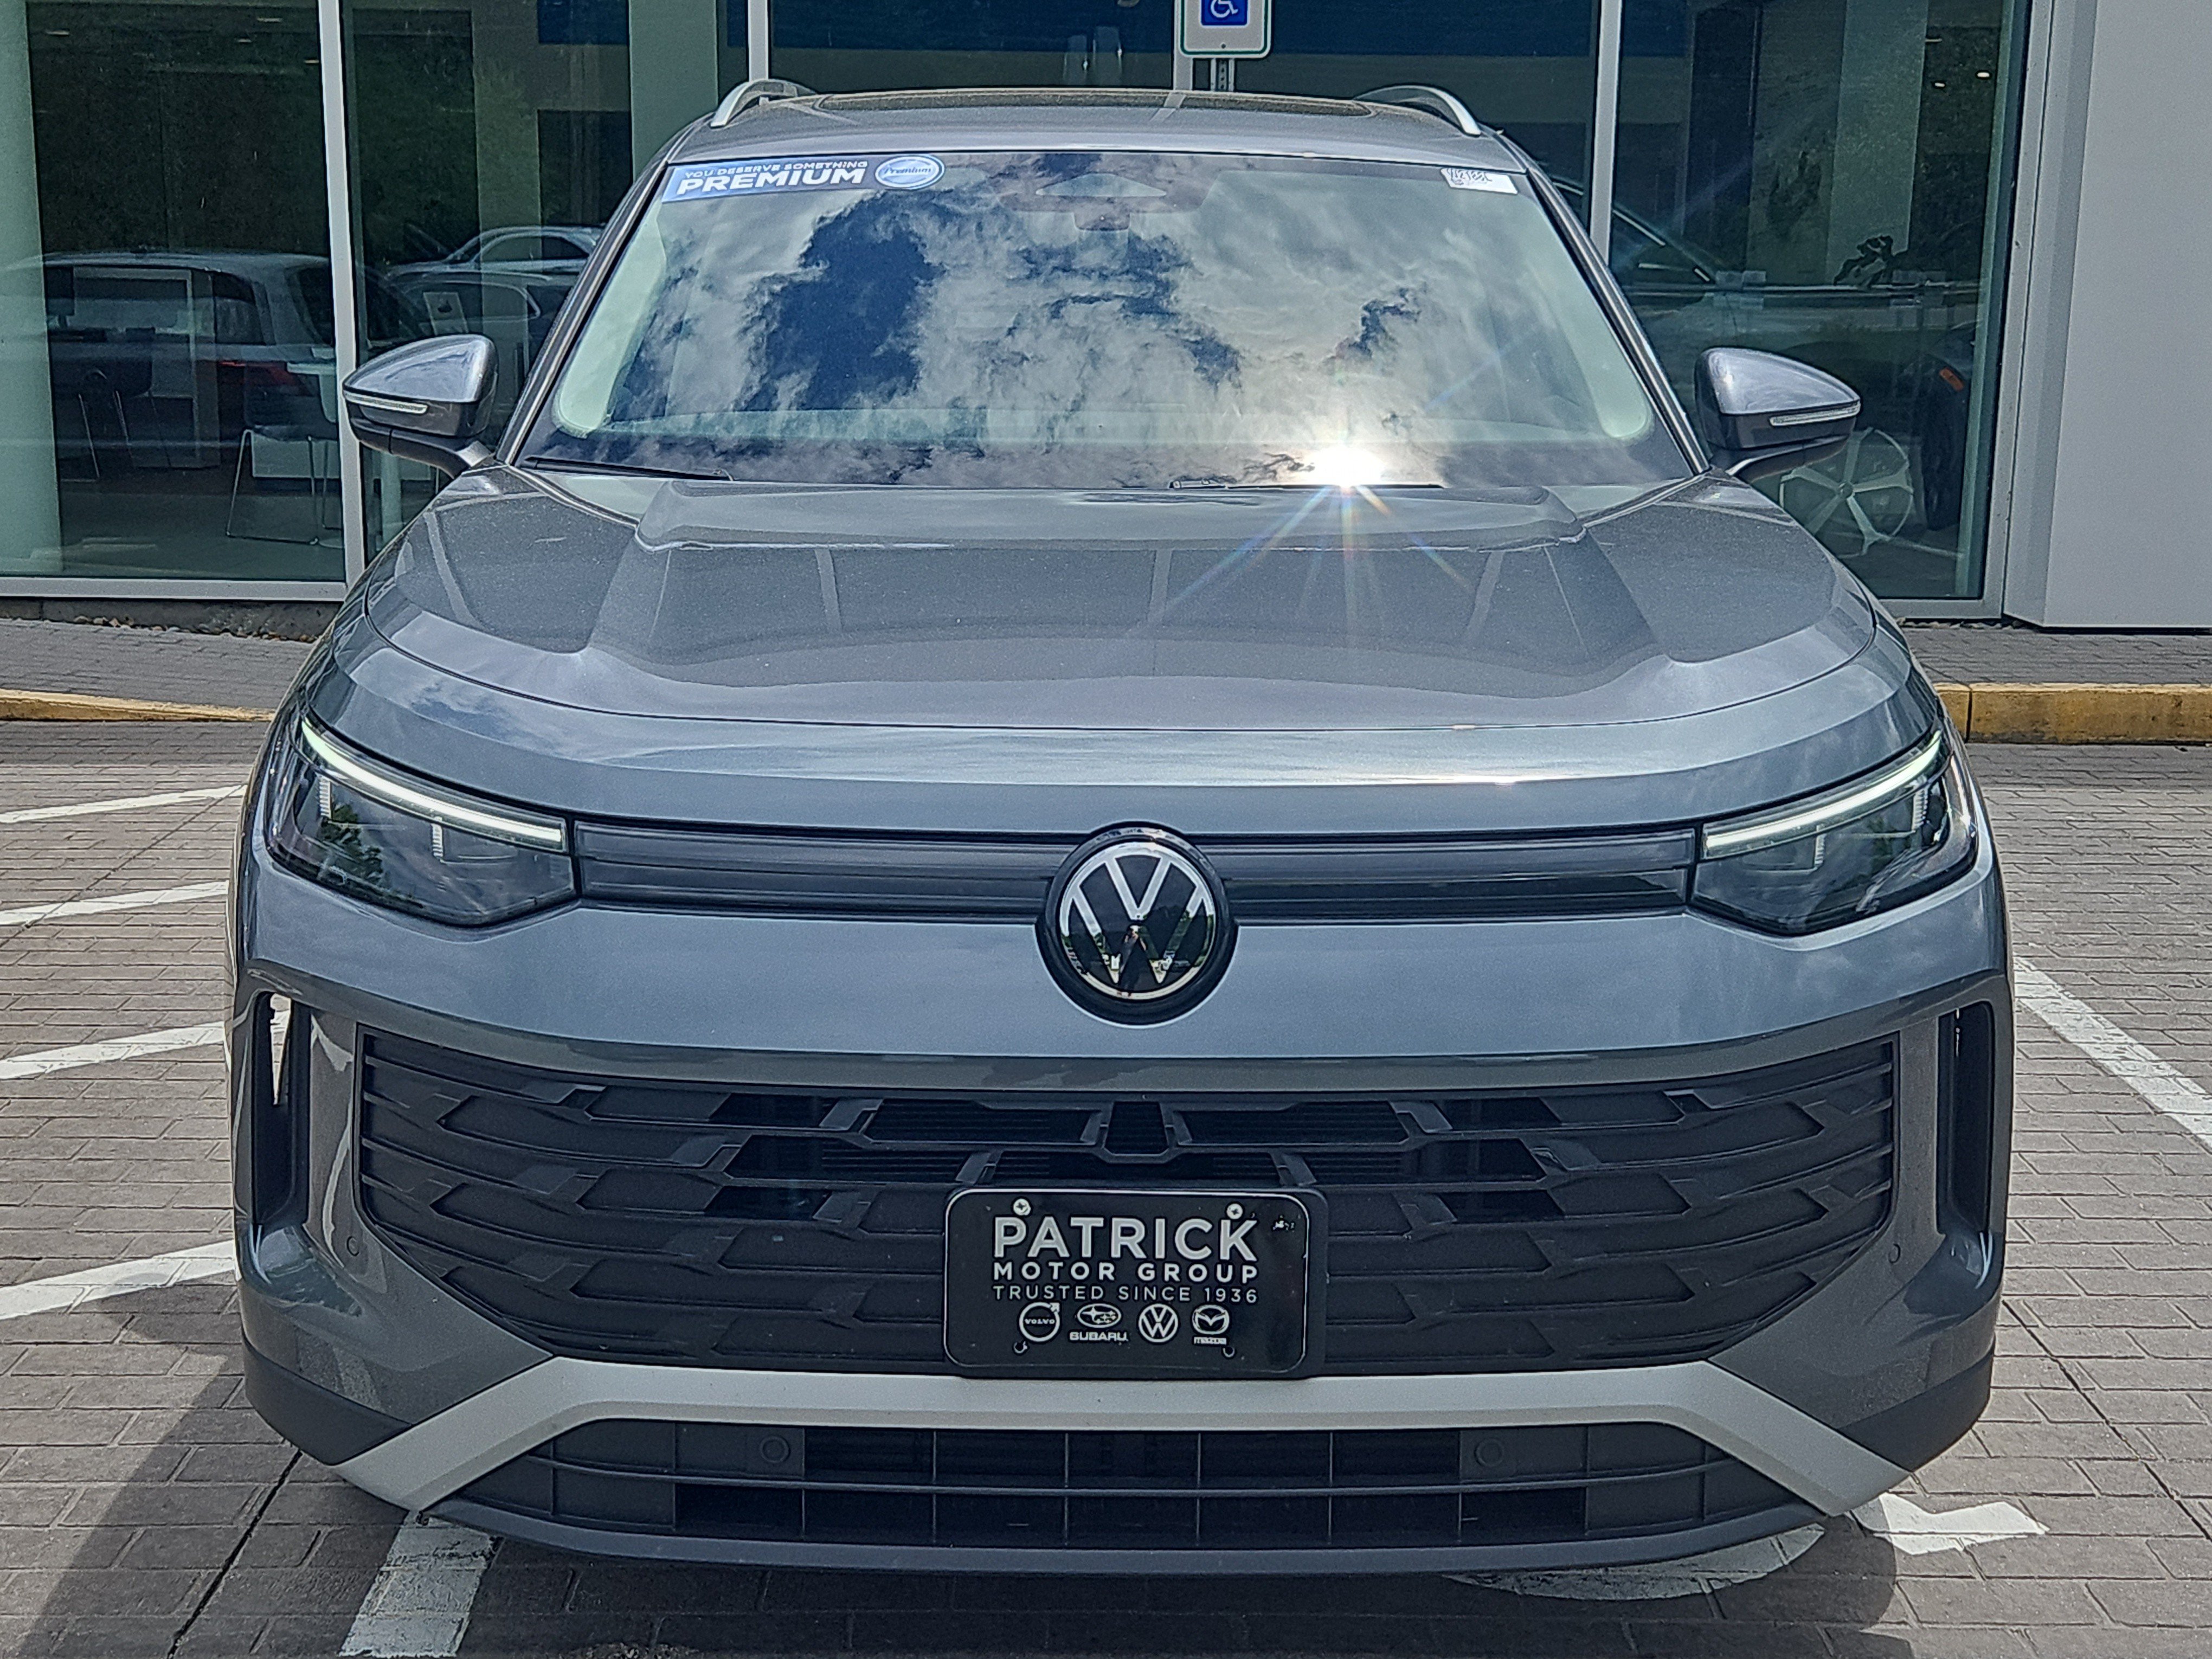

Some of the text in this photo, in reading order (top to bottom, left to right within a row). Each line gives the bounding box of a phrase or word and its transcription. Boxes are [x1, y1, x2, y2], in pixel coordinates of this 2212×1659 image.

[685, 160, 867, 178] YOU DESERVE SOMETHING
[677, 168, 866, 195] PREMIUM
[994, 1216, 1257, 1261] PATRICK
[994, 1262, 1257, 1284] MOTOR GROUP
[993, 1285, 1257, 1303] TRUSTED SINCE 1936
[1070, 1332, 1128, 1341] SUBARU
